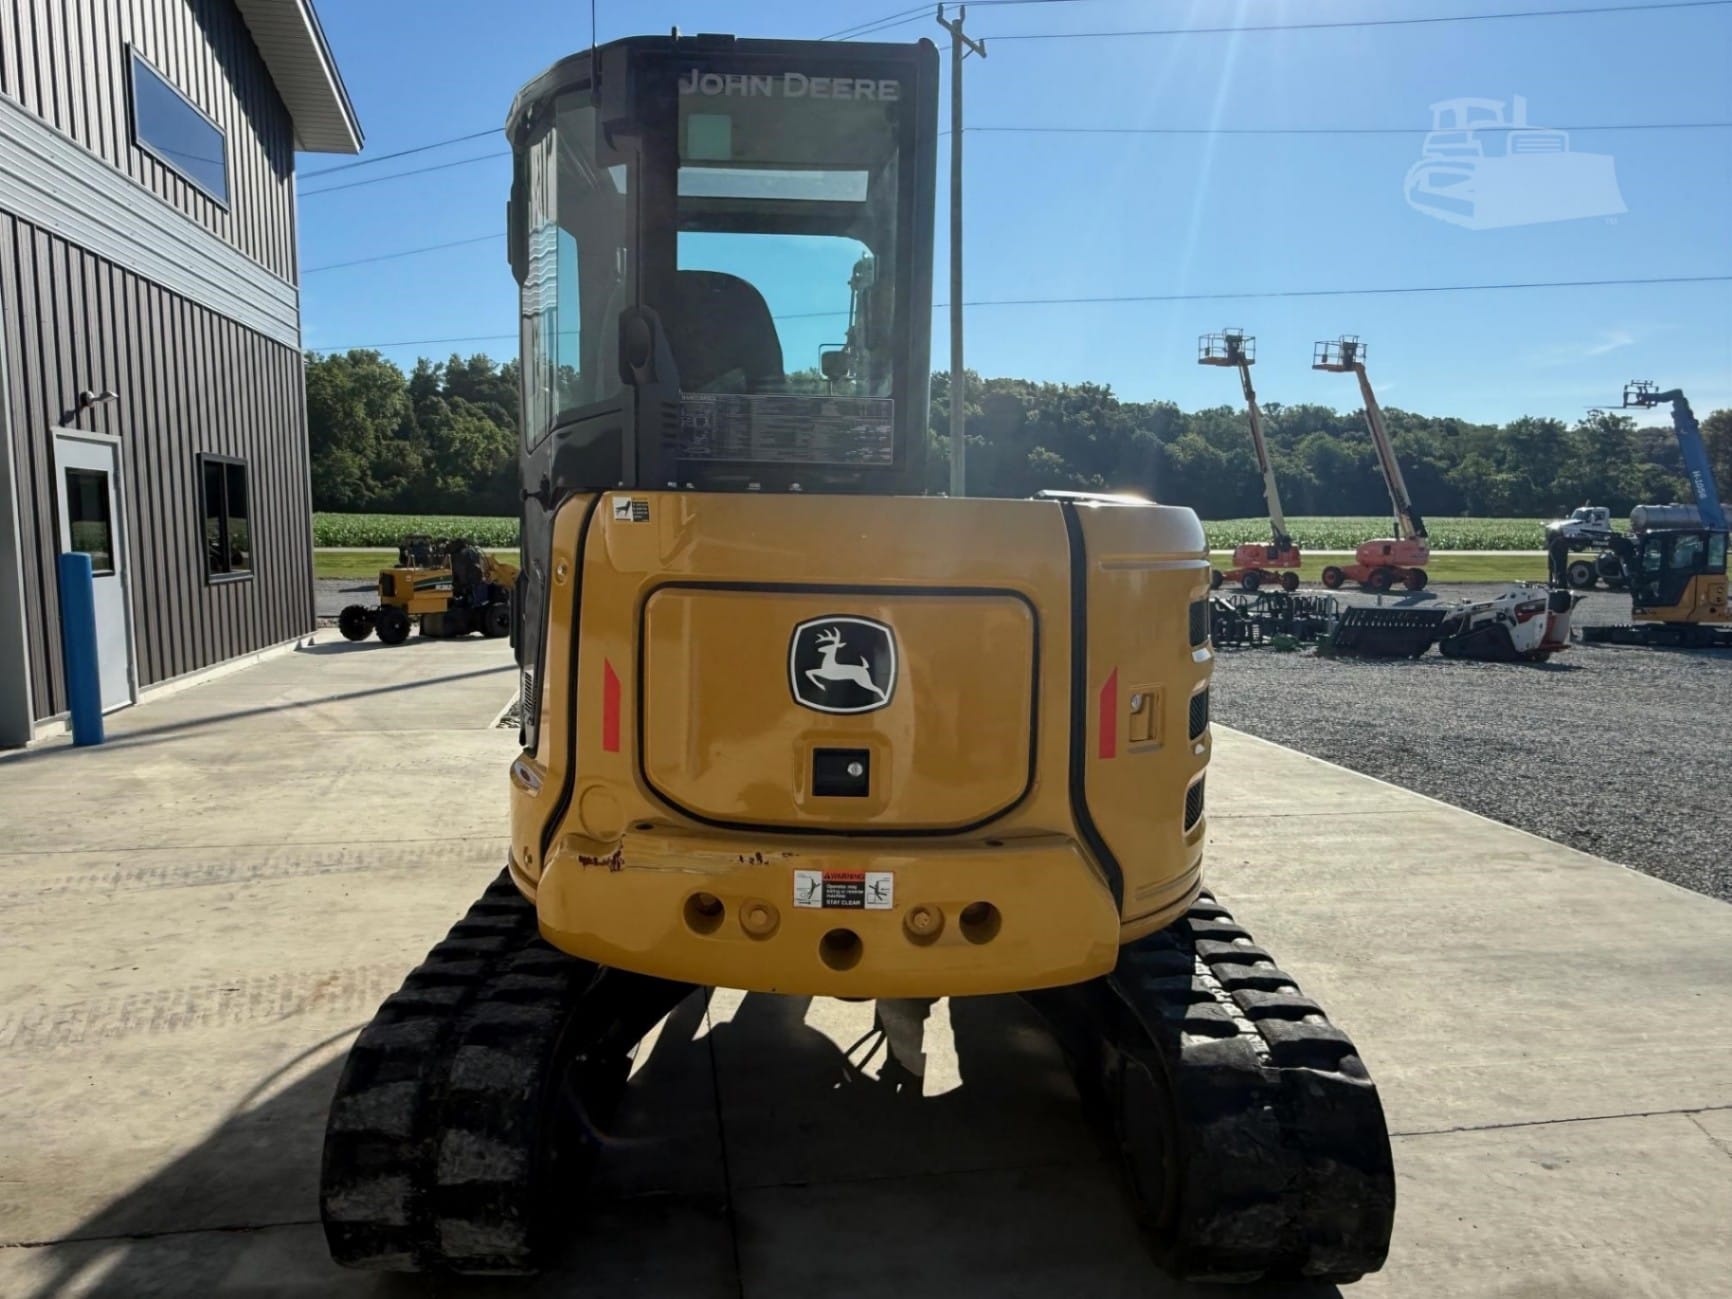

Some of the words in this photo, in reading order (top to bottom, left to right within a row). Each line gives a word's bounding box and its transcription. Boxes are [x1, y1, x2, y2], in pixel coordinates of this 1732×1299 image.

[678, 68, 772, 97] JOHN
[784, 72, 899, 101] DEERE
[831, 872, 864, 880] WARNING
